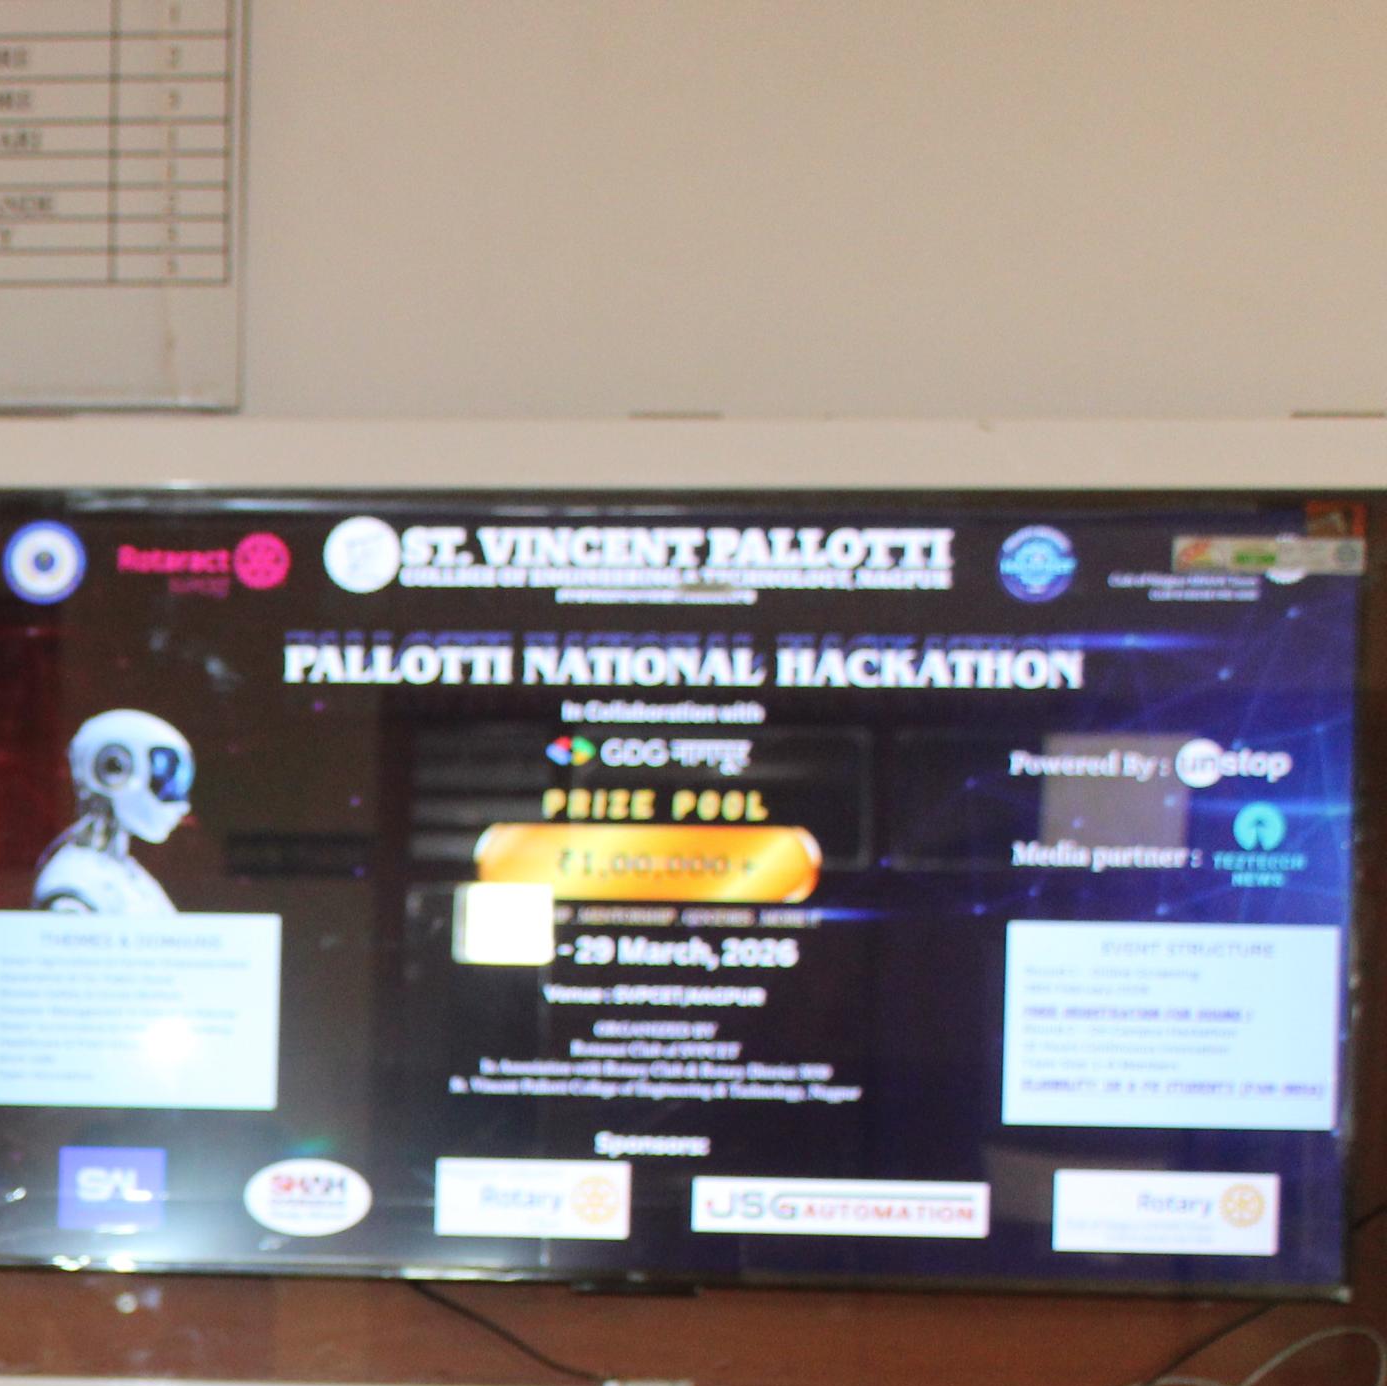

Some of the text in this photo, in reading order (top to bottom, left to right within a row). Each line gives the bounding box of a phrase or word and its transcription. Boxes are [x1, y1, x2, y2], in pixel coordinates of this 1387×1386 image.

[117, 543, 231, 575] Rotaract
[400, 526, 475, 567] ST.
[477, 526, 705, 567] VINCENT
[706, 528, 955, 569] PALLOTTI
[283, 645, 1084, 690] PALLOTTI NATIONAL HACKATHON
[584, 700, 717, 724] Collaboration
[718, 701, 767, 724] with
[600, 738, 668, 768] GDG
[1009, 750, 1118, 777] Powered
[1122, 751, 1158, 783] By
[541, 788, 769, 822] PRIZE POOL
[1012, 842, 1090, 868] Media
[1092, 844, 1189, 872] partner
[573, 936, 616, 965] 29
[617, 937, 719, 972] March,
[722, 938, 799, 968] 2026
[480, 1185, 566, 1214] Rotary
[802, 1200, 977, 1224] AUTOMATION
[1138, 1192, 1215, 1219] Rotary
